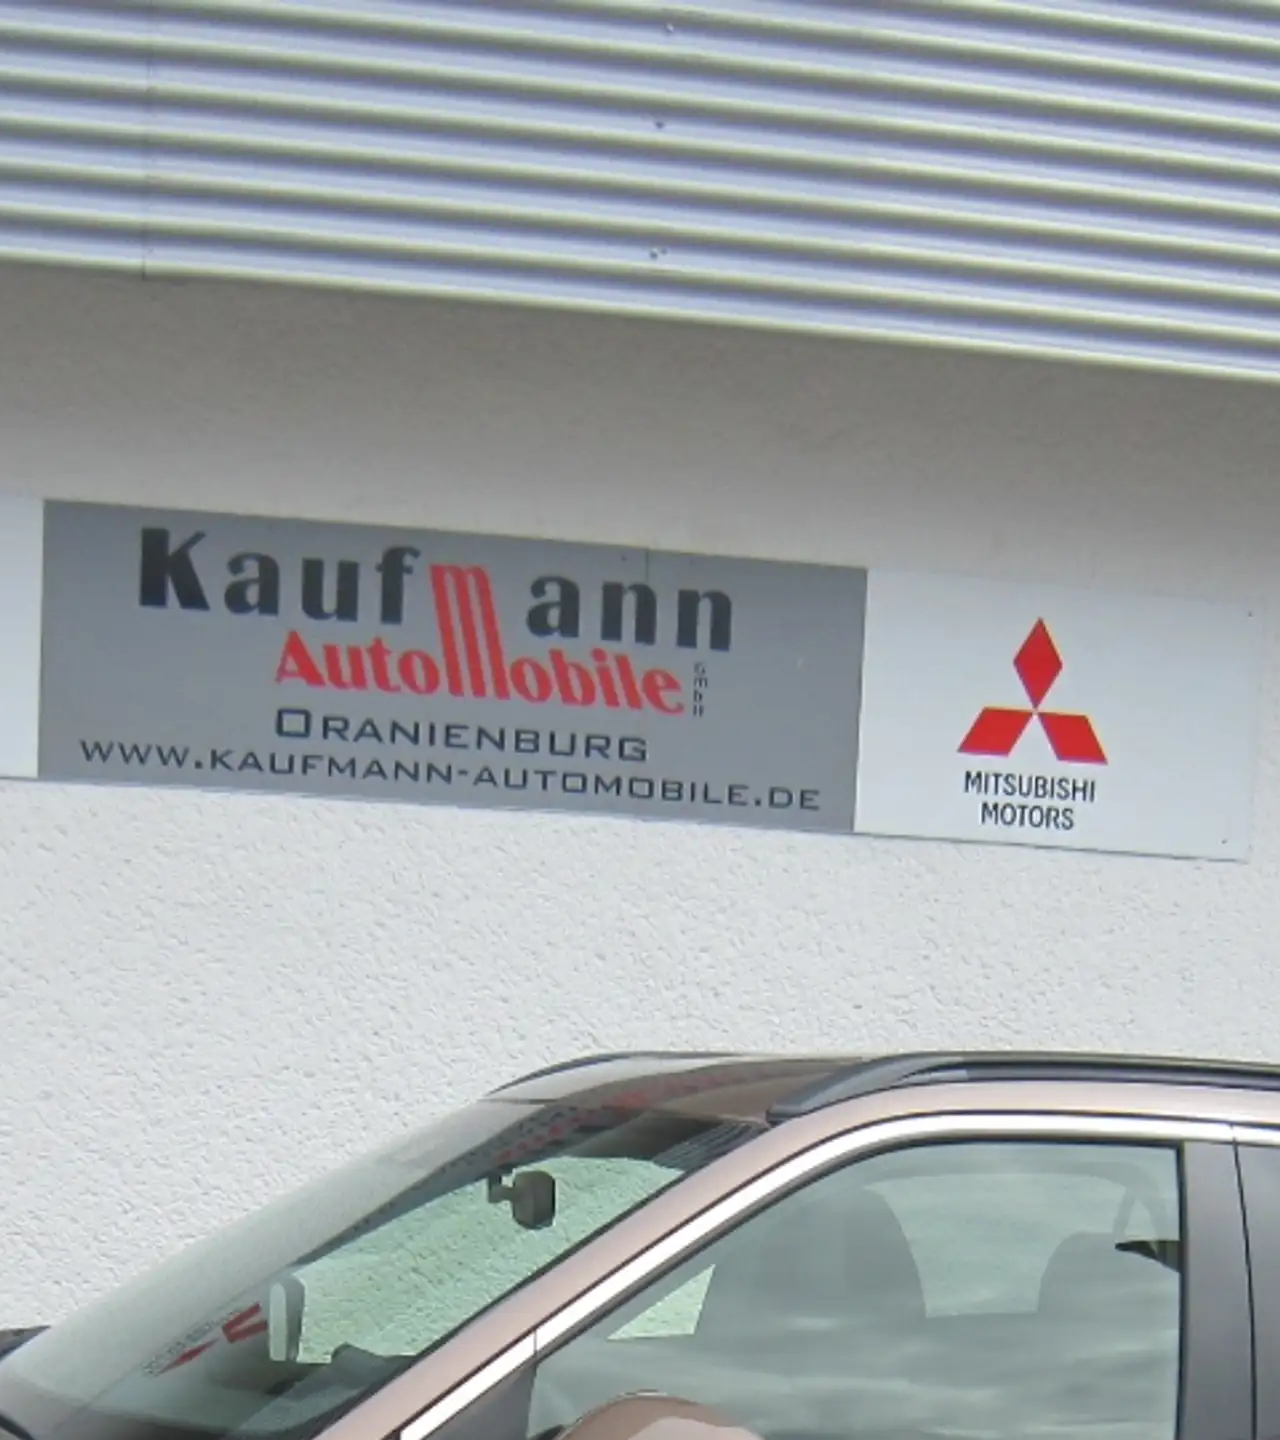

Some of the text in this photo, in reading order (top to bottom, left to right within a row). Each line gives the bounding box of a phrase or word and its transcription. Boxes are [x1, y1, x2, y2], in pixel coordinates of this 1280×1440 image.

[138, 526, 734, 668] Kaufmann
[276, 707, 648, 763] ORANIENBURG
[79, 739, 821, 811] WWW.KAUFMANN-AUTOMOBILE.DE
[963, 770, 1096, 803] MITSUBISHI
[980, 803, 1075, 831] MOTORS
